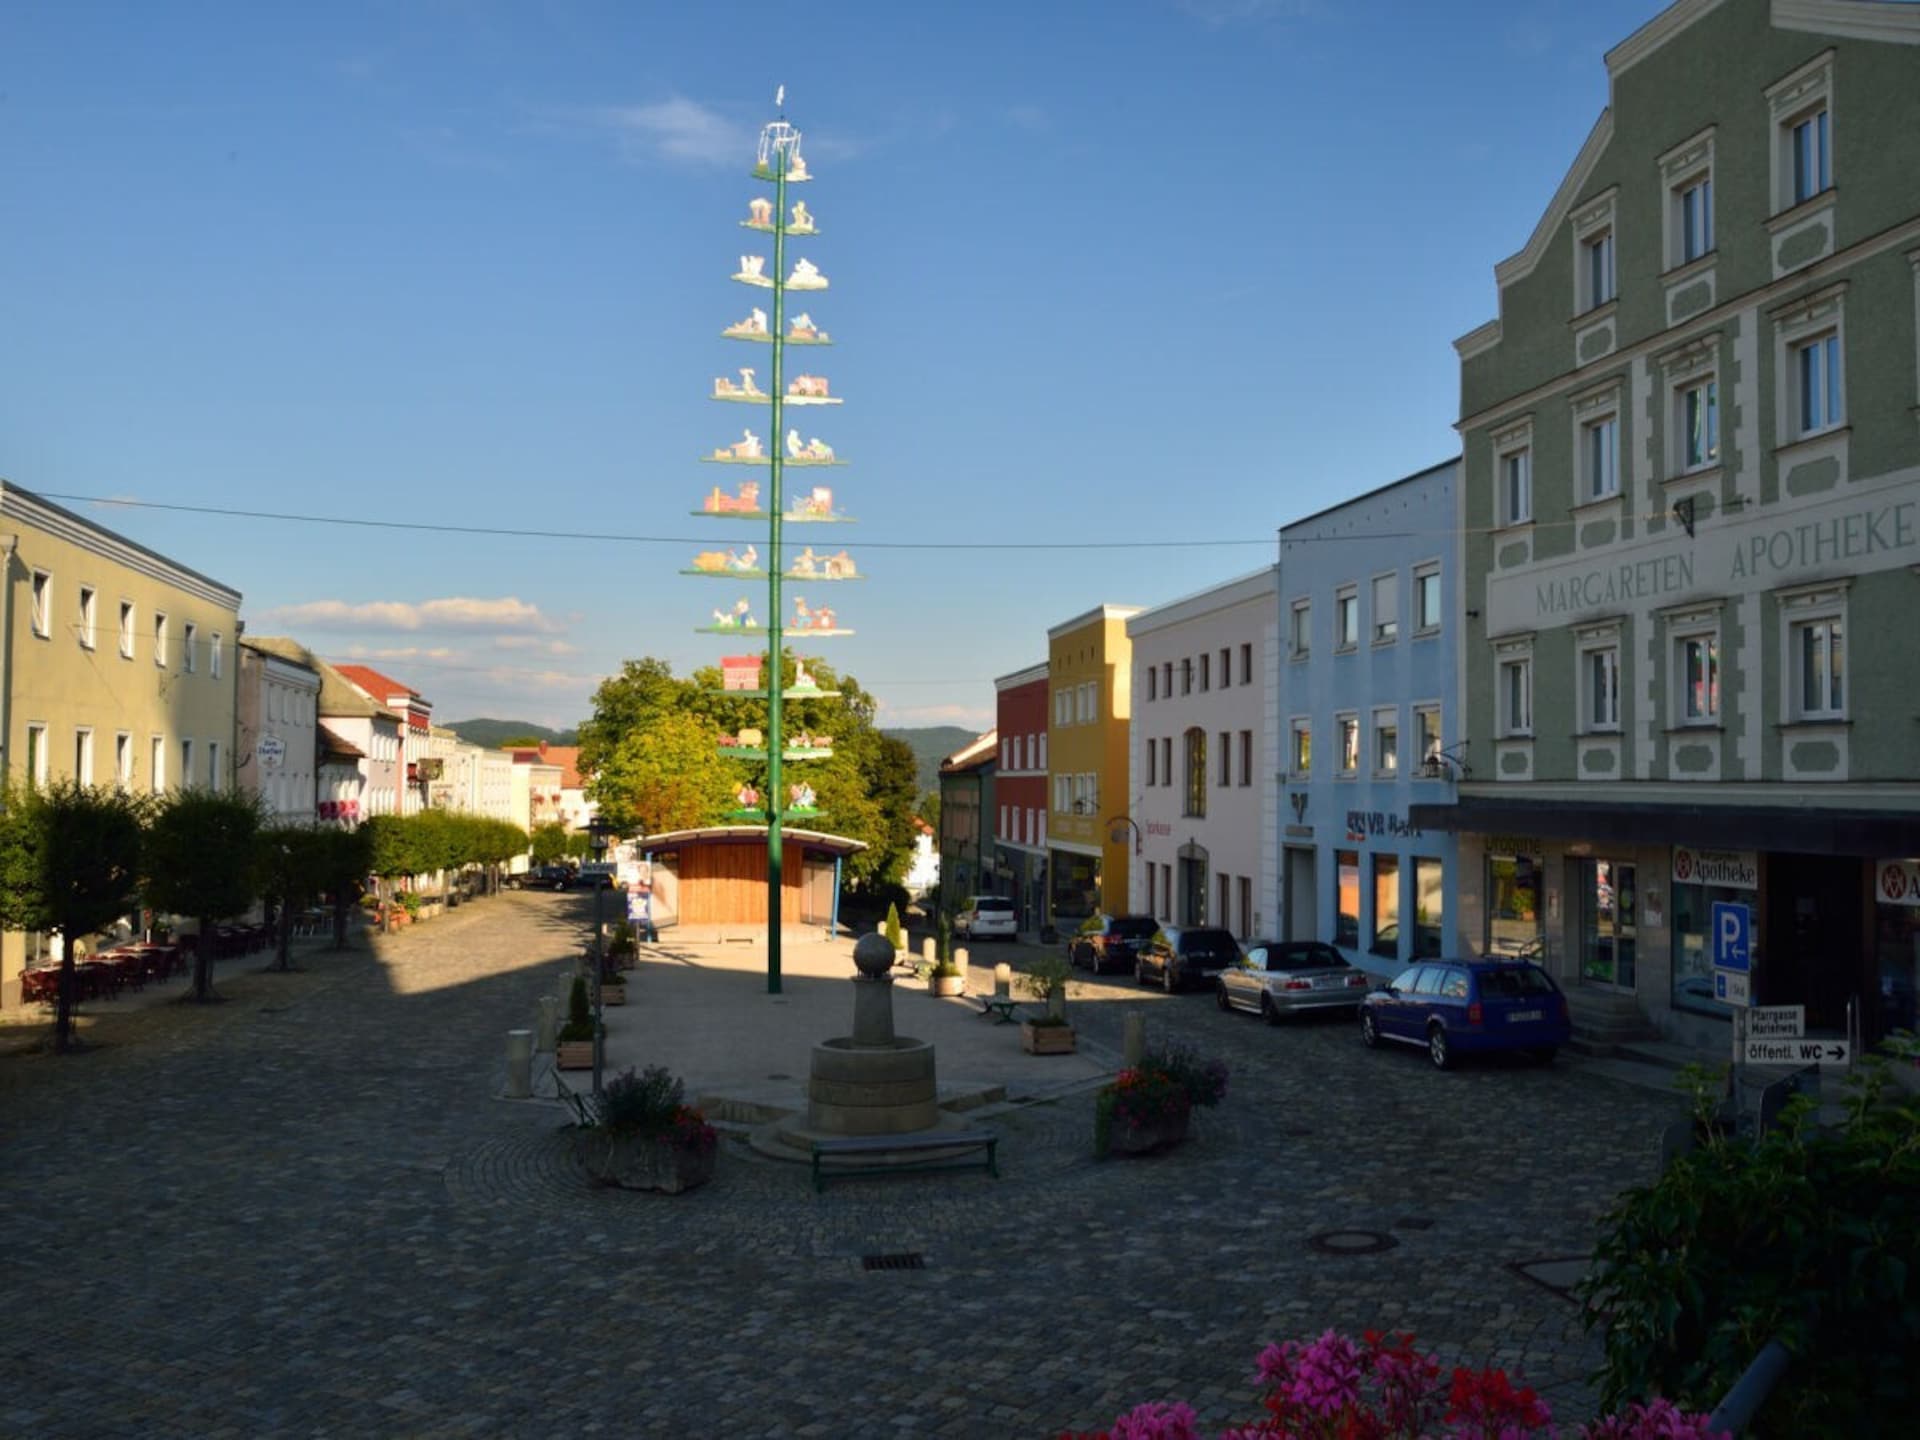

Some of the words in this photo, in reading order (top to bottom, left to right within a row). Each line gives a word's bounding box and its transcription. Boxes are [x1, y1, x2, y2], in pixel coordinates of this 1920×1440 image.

[1536, 552, 1695, 616] MARGARETEN
[1731, 502, 1916, 579] APOTHEKE
[1695, 860, 1755, 883] Apotheke
[1721, 911, 1741, 960] P
[1749, 1043, 1794, 1060] öffentl.
[1799, 1044, 1823, 1060] WC
